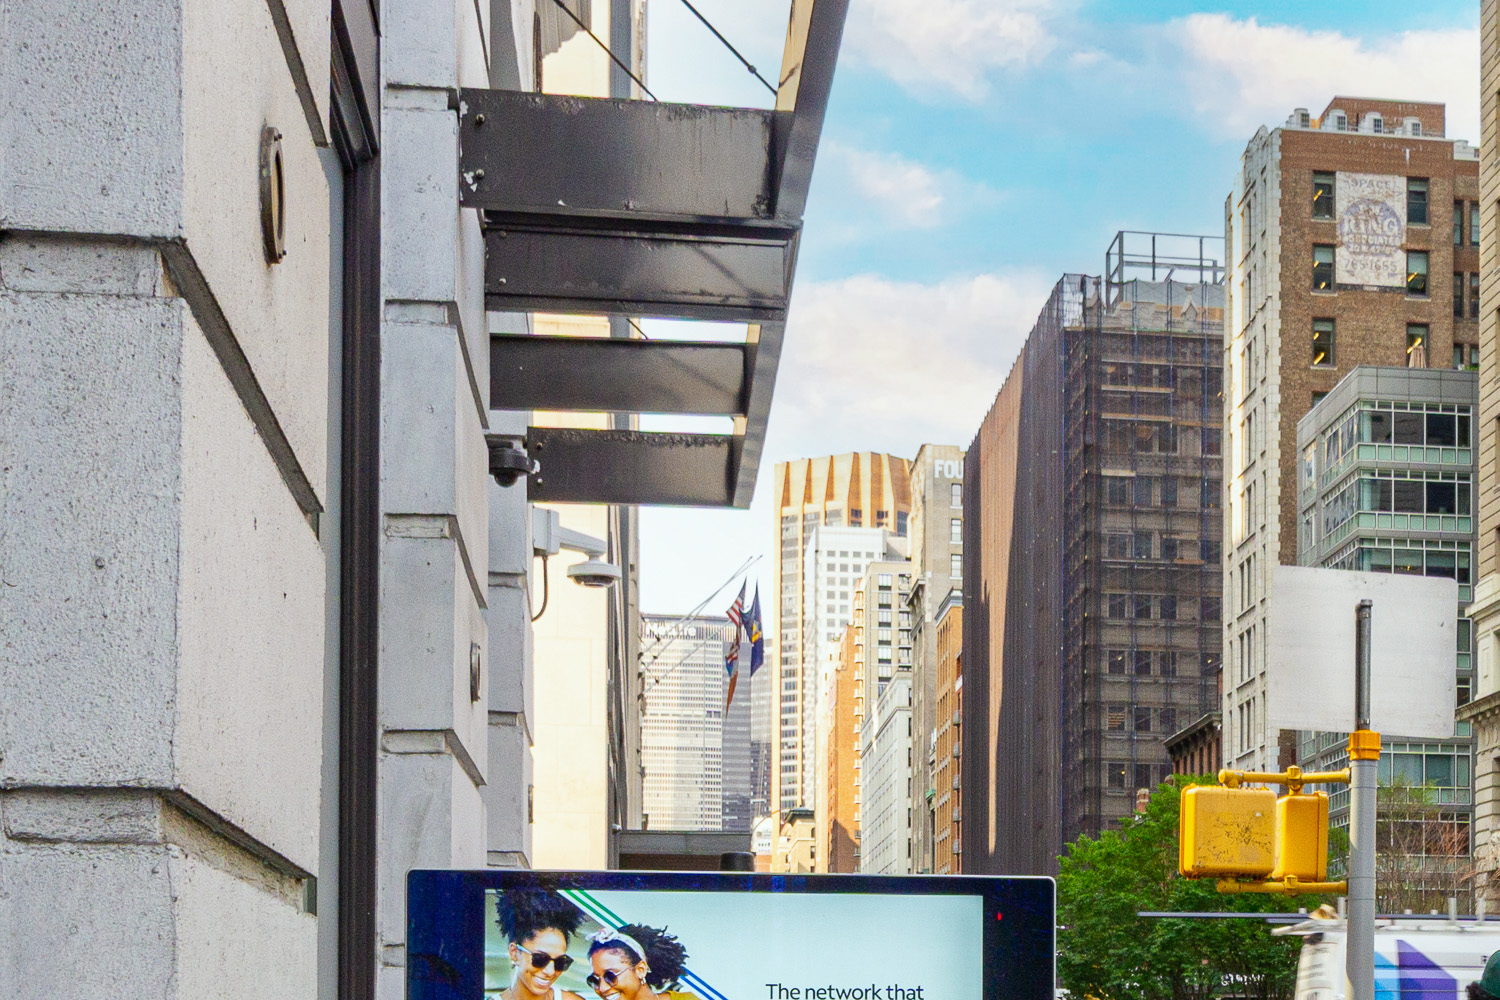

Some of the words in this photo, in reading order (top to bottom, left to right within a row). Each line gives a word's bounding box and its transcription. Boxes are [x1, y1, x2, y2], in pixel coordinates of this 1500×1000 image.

[765, 983, 801, 1000] The
[805, 983, 883, 1000] network
[886, 983, 925, 1000] that
